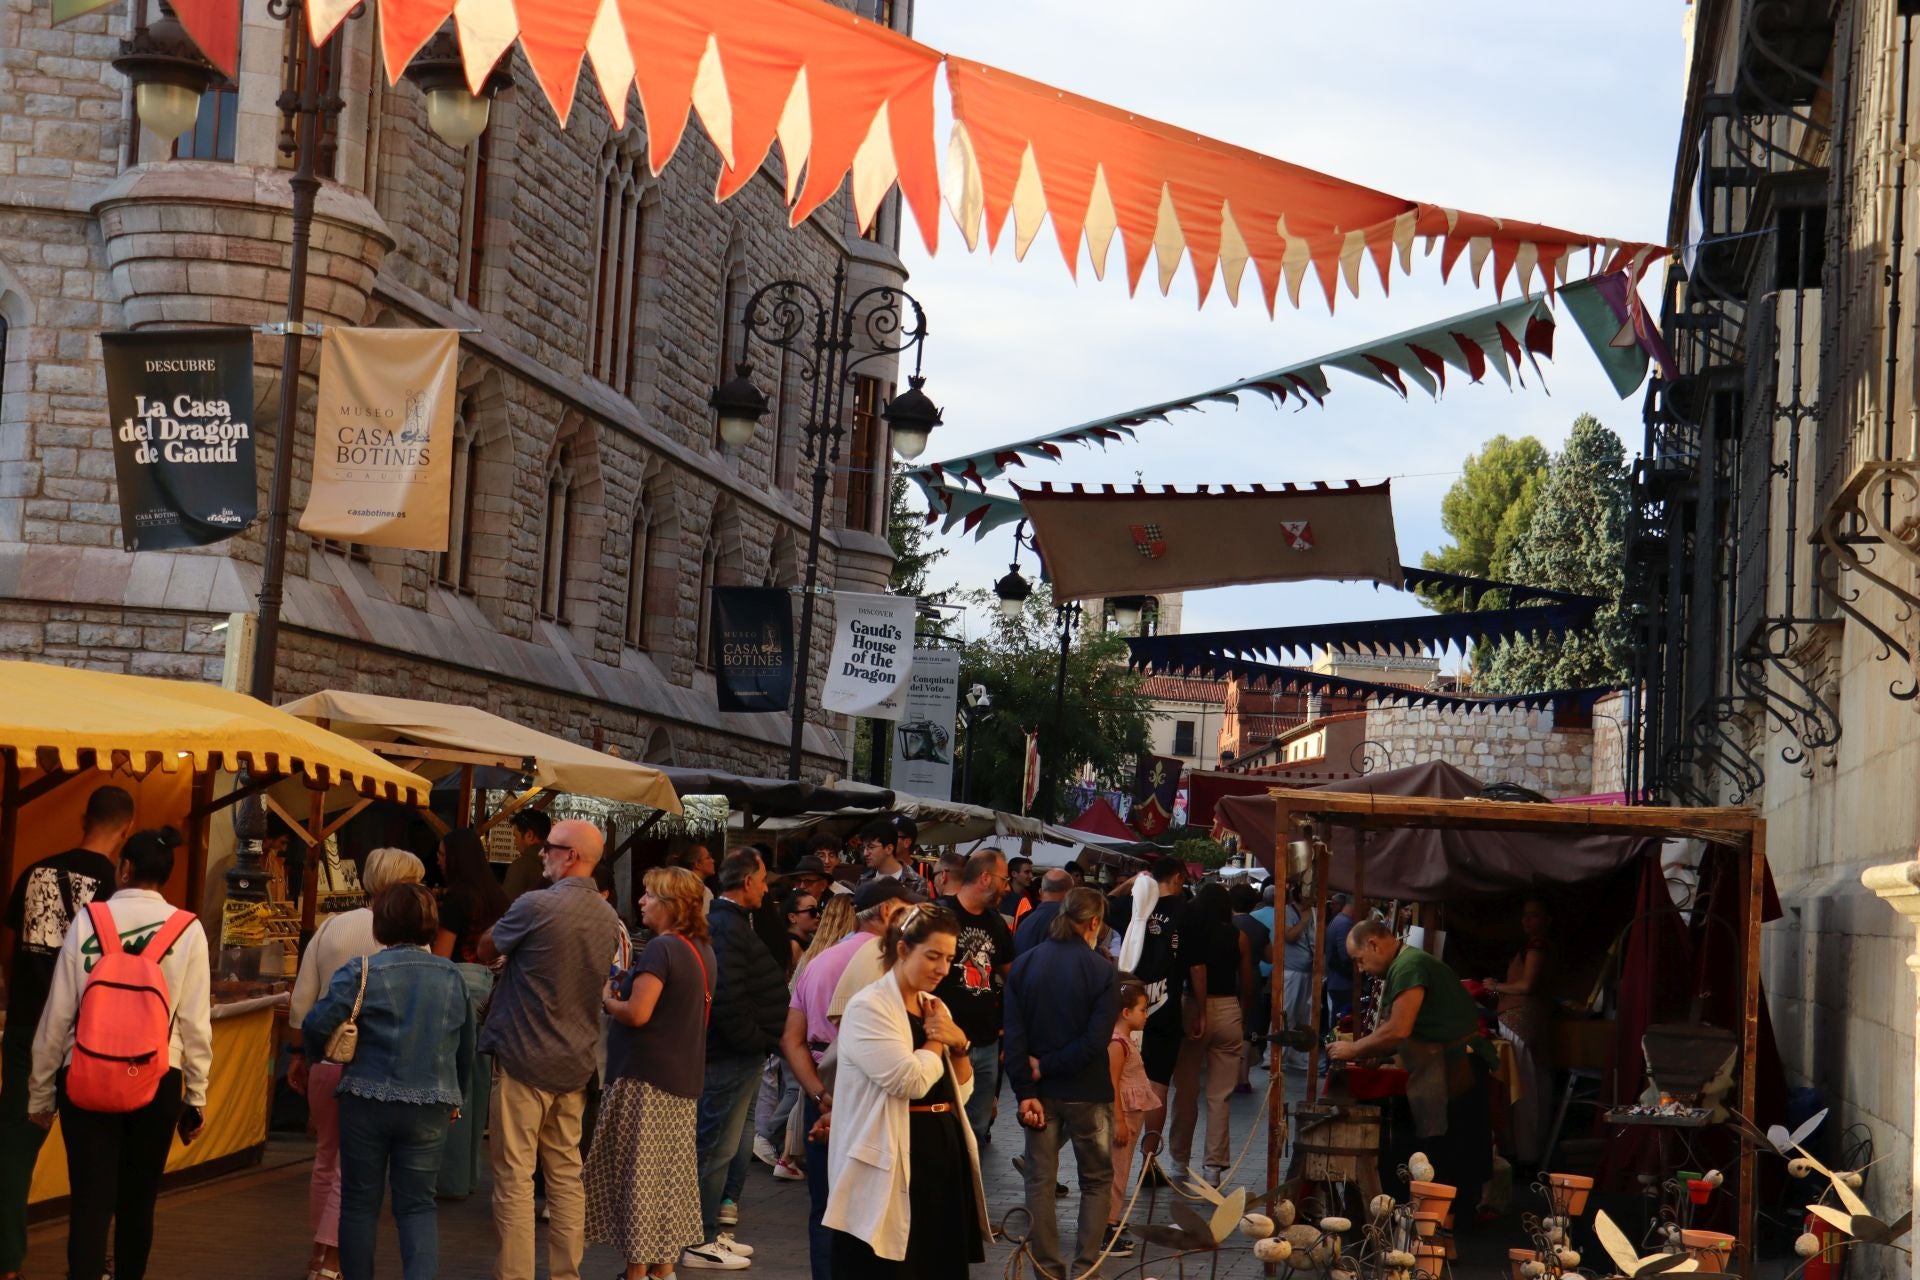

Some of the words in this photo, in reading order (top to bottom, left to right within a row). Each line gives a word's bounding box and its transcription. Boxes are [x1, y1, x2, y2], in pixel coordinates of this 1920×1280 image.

[145, 359, 216, 372] DESCUBRE
[135, 395, 167, 418] La
[173, 394, 231, 418] Casa
[340, 406, 394, 418] MUSEO
[118, 417, 153, 443] del
[159, 417, 249, 445] Dragón
[338, 426, 396, 447] CASA
[135, 441, 159, 464] de
[164, 440, 238, 463] Gaudí
[337, 445, 430, 466] BOTINES
[135, 513, 153, 521] CASA
[347, 509, 406, 519] casabotines.es
[858, 607, 894, 618] DISCOVER
[850, 619, 902, 641] Gaudí's
[723, 643, 759, 655] CASA
[852, 634, 897, 654] House
[723, 654, 783, 666] BOTINES
[851, 650, 869, 664] of
[870, 652, 894, 668] the
[842, 662, 897, 684] Dragon
[913, 674, 955, 686] Conquista
[910, 683, 924, 692] del
[925, 684, 944, 693] Voto
